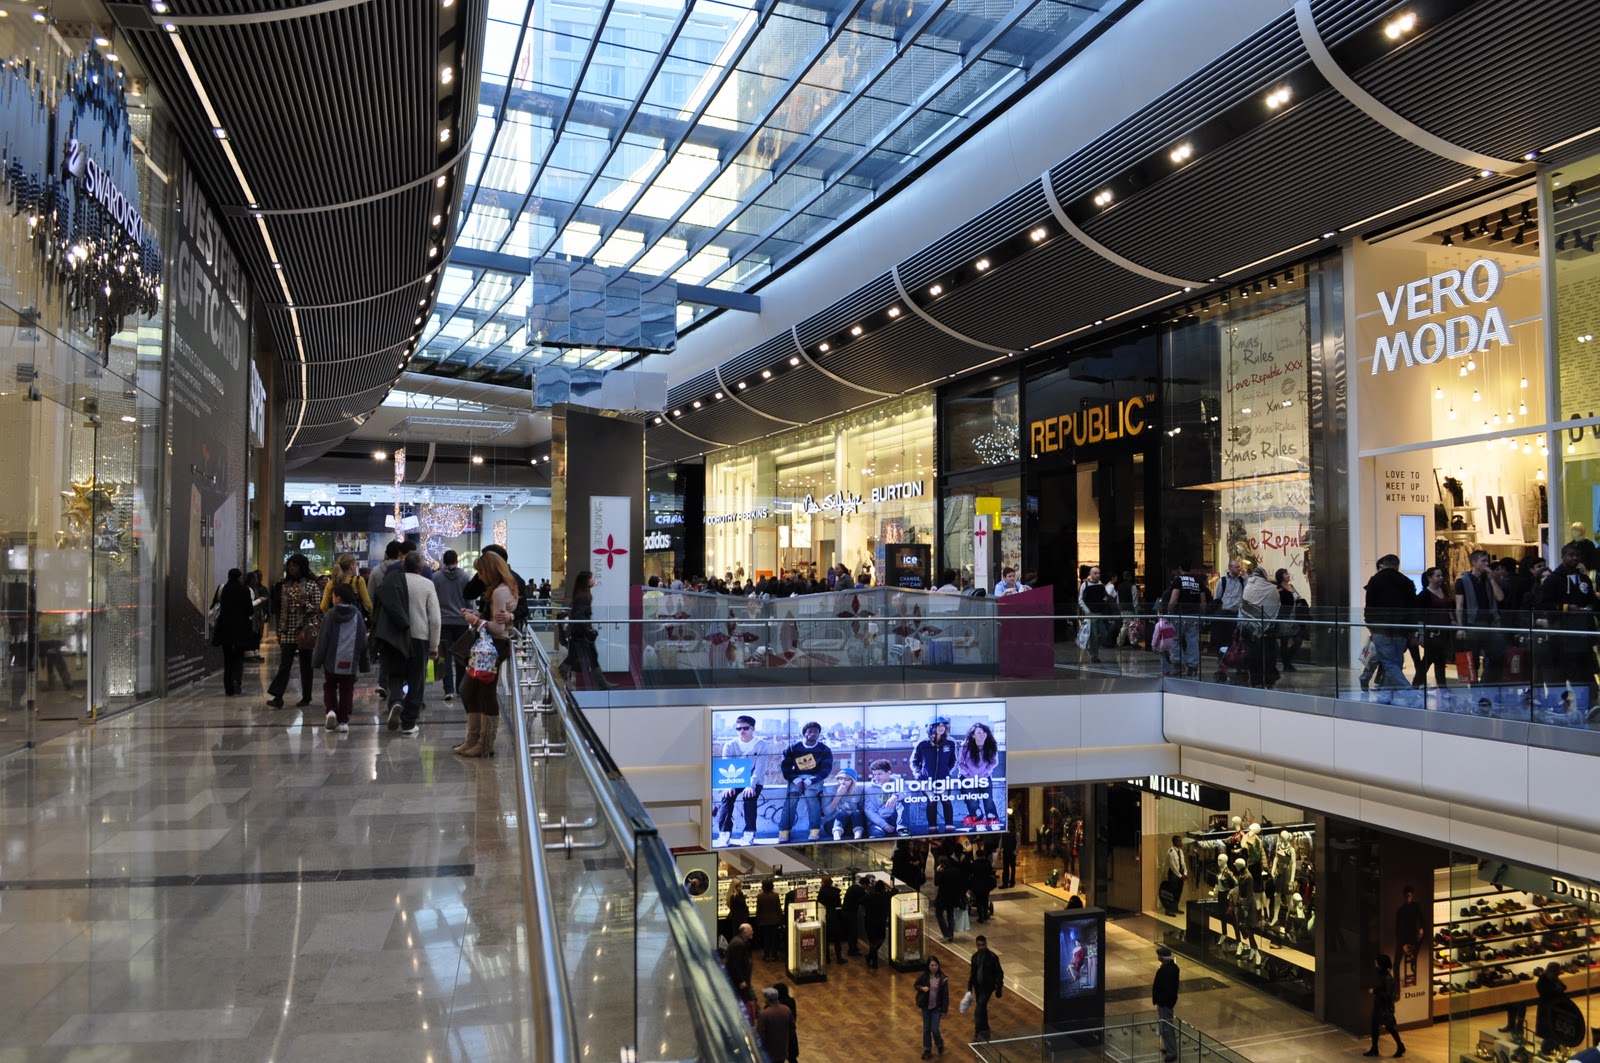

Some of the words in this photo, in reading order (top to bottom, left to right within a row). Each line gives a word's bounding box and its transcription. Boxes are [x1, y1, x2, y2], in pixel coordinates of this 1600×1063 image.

[86, 158, 143, 247] SWAROVSKI
[182, 156, 247, 321] WESTFIELD
[1377, 259, 1500, 326] VERO
[1230, 335, 1260, 349] Xmas
[1371, 307, 1510, 376] MODA
[1243, 343, 1274, 364] Rules
[1226, 380, 1250, 393] Love
[1251, 363, 1282, 385] Republic
[1267, 399, 1294, 415] Xm
[1031, 397, 1144, 455] REPUBLIC
[1225, 449, 1257, 466] Xmas
[1261, 433, 1297, 459] Rules
[1385, 471, 1405, 479] LOVE
[1411, 471, 1420, 479] TO
[872, 481, 923, 502] BURTON
[1385, 482, 1405, 490] MEET
[1386, 494, 1406, 502] WITH
[1411, 494, 1429, 502] YOU!
[302, 506, 345, 516] TCARD
[1486, 496, 1510, 534] M
[644, 531, 671, 550] adidas
[882, 778, 904, 793] all
[908, 774, 989, 794] originals
[1149, 775, 1200, 802] MILLEN
[904, 795, 927, 803] dare
[929, 794, 940, 802] to
[942, 793, 955, 801] be
[957, 792, 989, 802] unique
[1404, 991, 1426, 999] Dune
